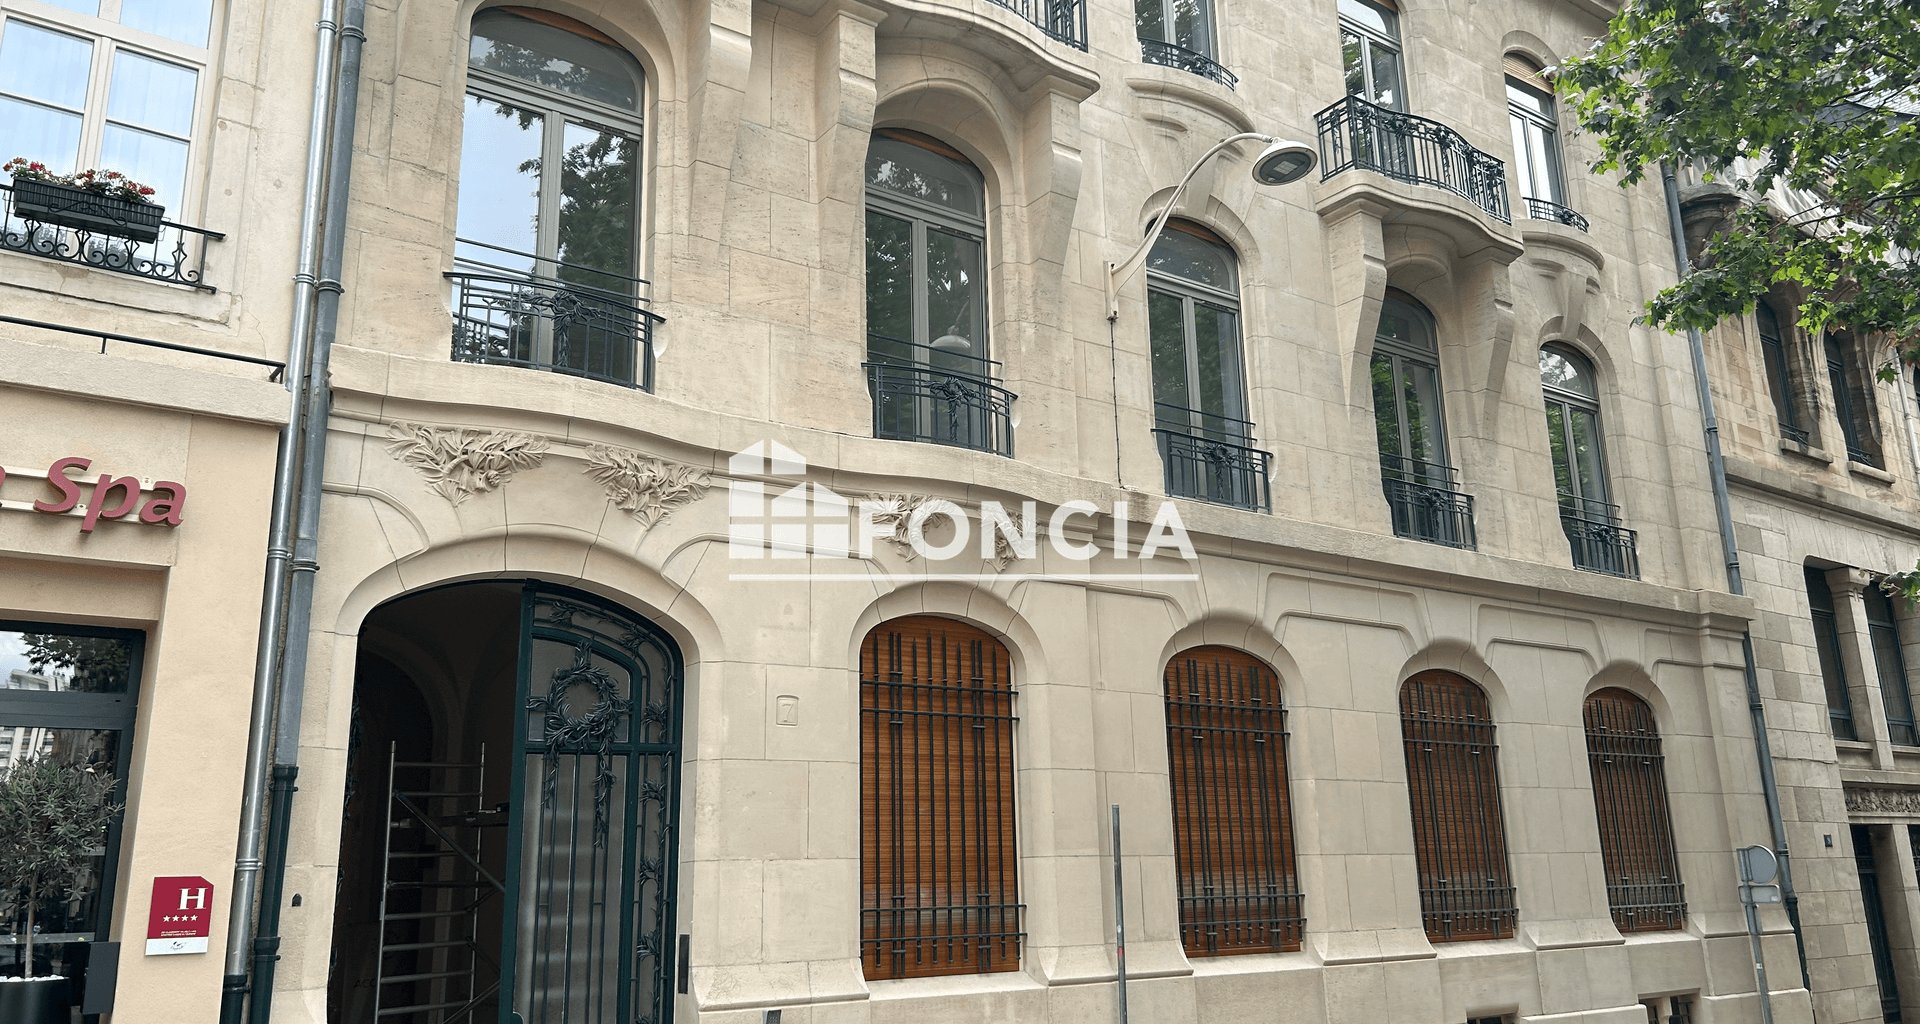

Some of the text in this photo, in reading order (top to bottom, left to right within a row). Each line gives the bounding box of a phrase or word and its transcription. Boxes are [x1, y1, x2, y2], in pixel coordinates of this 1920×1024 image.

[33, 456, 187, 533] Spa
[781, 703, 795, 723] 7
[177, 887, 208, 910] H
